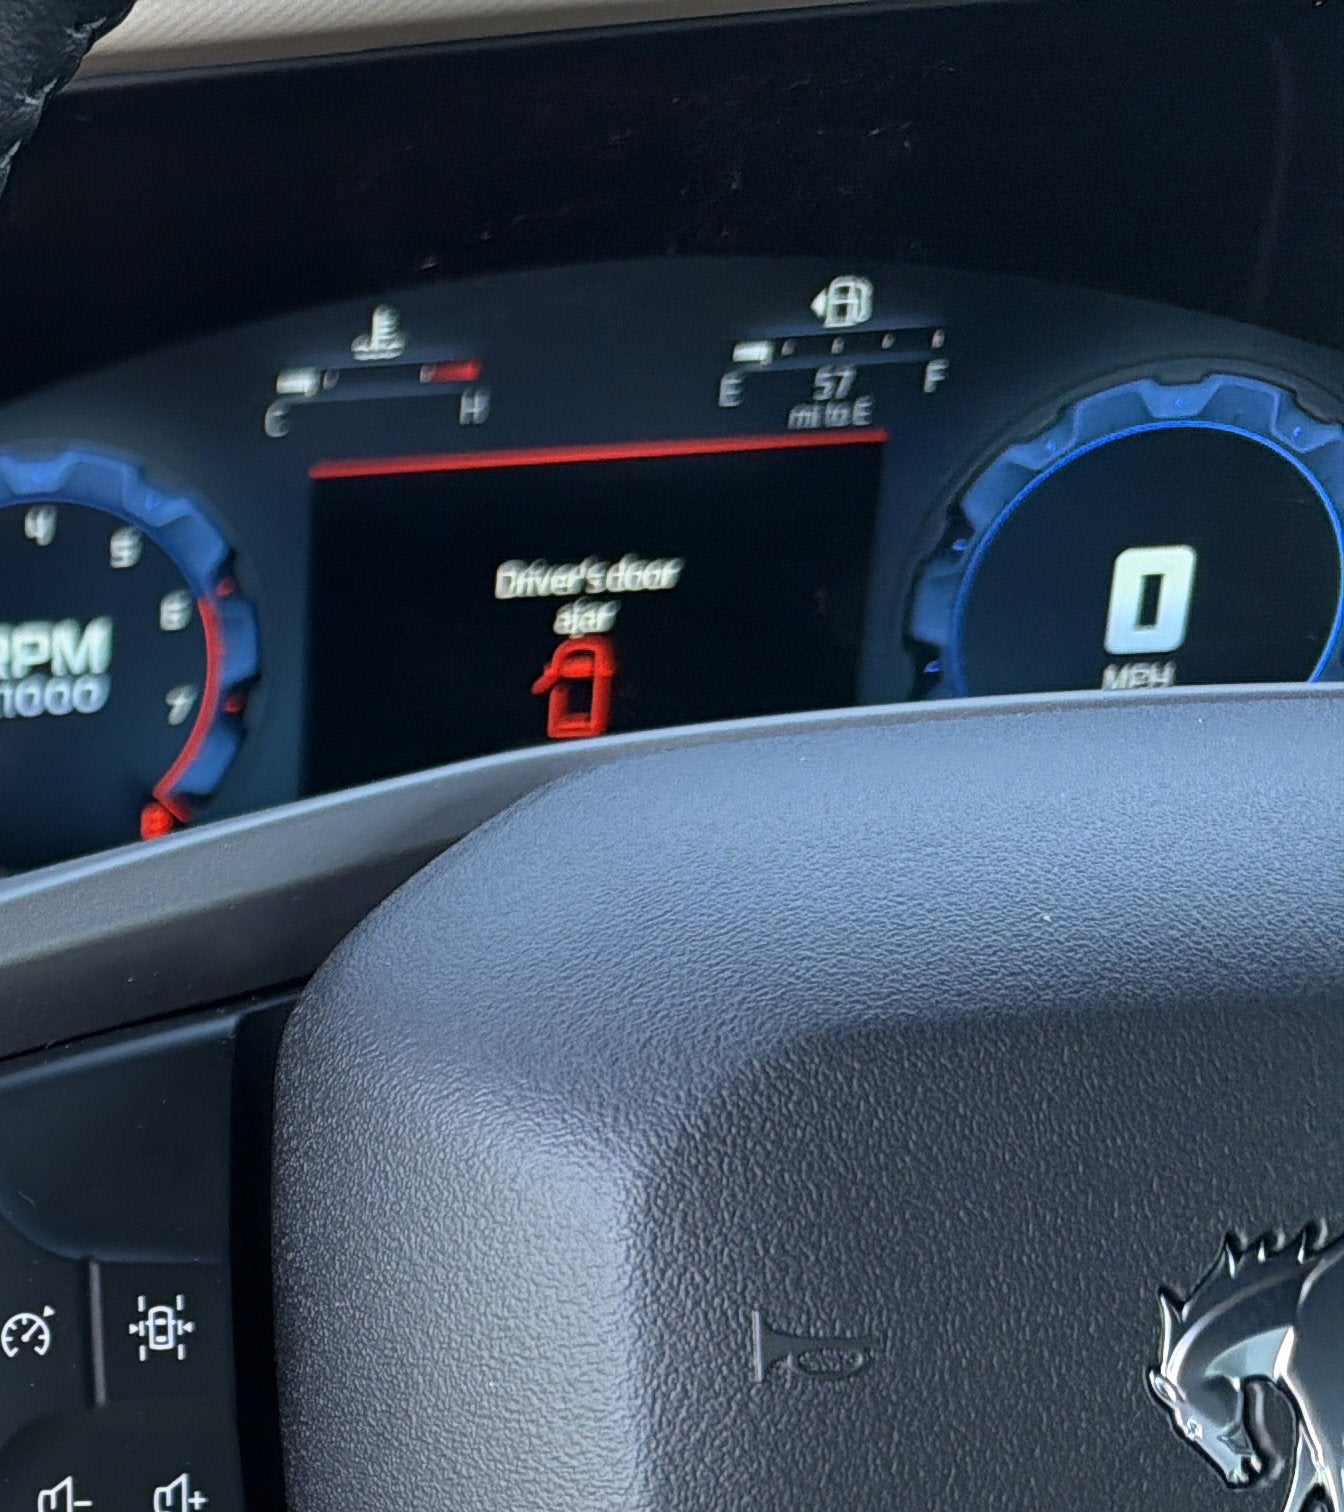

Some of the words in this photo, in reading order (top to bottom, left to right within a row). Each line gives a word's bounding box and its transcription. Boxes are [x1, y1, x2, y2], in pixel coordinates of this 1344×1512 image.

[719, 370, 743, 408] E
[812, 363, 857, 400] 57
[923, 358, 949, 393] F
[24, 504, 57, 546] 4
[495, 556, 609, 599] Driver's
[606, 553, 685, 592] door
[553, 597, 621, 638] ajar
[1104, 544, 1197, 655] 0
[1102, 661, 1177, 690] MPH
